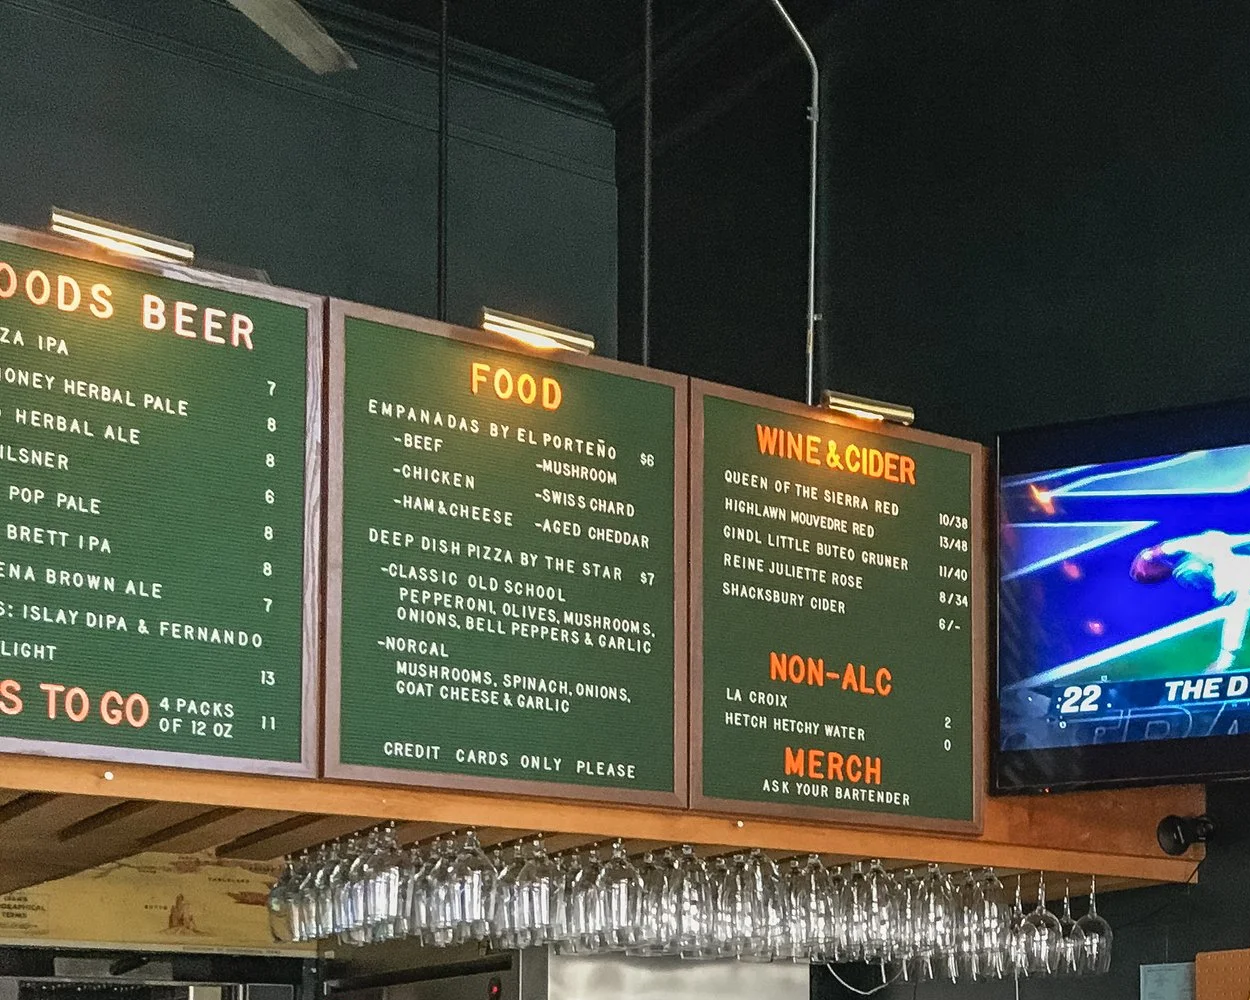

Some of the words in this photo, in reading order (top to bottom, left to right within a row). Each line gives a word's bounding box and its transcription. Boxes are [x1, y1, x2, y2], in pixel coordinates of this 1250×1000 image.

[143, 294, 253, 349] BEER
[39, 336, 68, 355] IPA
[267, 381, 276, 396] 7
[471, 362, 563, 410] FOOD
[0, 368, 55, 390] ONEY
[64, 379, 135, 406] HERBAL
[144, 394, 188, 416] PALE
[268, 417, 276, 432] 8
[16, 409, 93, 436] HERBAL
[105, 425, 140, 444] ALE
[266, 454, 275, 467] 8
[369, 399, 479, 433] EMPANADAS
[490, 423, 509, 438] BY
[518, 428, 537, 444] EL
[641, 453, 654, 466] $6
[394, 433, 443, 452] -BEEF
[536, 459, 616, 485] -MUSHROOM
[9, 486, 44, 504] POP
[57, 493, 101, 514] PALE
[264, 526, 273, 540] 8
[265, 489, 274, 503] 6
[393, 465, 474, 489] -CHICKEN
[535, 489, 585, 508] -SWISS
[590, 498, 634, 517] CHARD
[725, 470, 767, 490] QUEEN
[775, 480, 790, 493] OF
[795, 484, 817, 500] THE
[824, 490, 868, 510] SIERRA
[875, 500, 898, 515] RED
[940, 513, 967, 529] 10/38
[535, 519, 580, 536] -AGED
[588, 527, 648, 548] CHEDDAR
[725, 498, 785, 521] HIGHLAWN
[791, 511, 847, 532] MOUVEDRE
[853, 523, 874, 537] RED
[940, 536, 967, 551] 13/48
[7, 524, 69, 546] BRETT
[79, 535, 110, 553] IPA
[263, 562, 272, 576] 8
[369, 528, 414, 547] DEEP
[422, 536, 460, 555] DISH
[468, 544, 512, 563] PIZZA
[521, 552, 538, 567] BY
[545, 556, 574, 573] THE
[583, 563, 621, 580] STAR
[641, 572, 654, 585] $7
[724, 526, 761, 543] GINDL
[768, 534, 809, 552] LITTLE
[817, 543, 854, 560] BUTEO
[862, 551, 908, 570] GRUNER
[940, 566, 967, 581] 11/40
[46, 569, 114, 591] BROWN
[125, 580, 162, 598] ALE
[263, 598, 272, 612] 7
[381, 563, 457, 585] -CLASSIC
[468, 575, 498, 591] OLD
[505, 580, 565, 602] SCHOOL
[724, 553, 764, 572] REINE
[769, 562, 826, 583] JULIETTE
[832, 573, 862, 589] ROSE
[940, 592, 968, 607] 8/34
[24, 605, 78, 624] ISLAY
[87, 612, 127, 631] DIPA
[138, 619, 149, 634] &
[160, 622, 262, 647] FERNANDO
[723, 582, 804, 606] SHACKSBURY
[811, 597, 845, 613] CIDER
[939, 618, 960, 631] 6/-
[378, 636, 448, 657] -NORCAL
[466, 616, 505, 634] BELL
[512, 622, 579, 644] PEPPERS
[585, 633, 593, 646] &
[599, 635, 651, 653] GARLIC
[1, 641, 56, 660] LIGHT
[261, 671, 275, 685] 13
[769, 651, 892, 697] NON-ALC
[0, 680, 22, 714] S
[40, 684, 89, 721] TO
[101, 691, 148, 727] GO
[160, 697, 169, 711] 4
[177, 699, 234, 717] PACKS
[396, 680, 433, 696] GOAT
[440, 686, 499, 704] CHEESE
[504, 693, 512, 706] &
[517, 695, 569, 713] GARLIC
[727, 688, 741, 701] LA
[750, 691, 787, 708] CROIX
[945, 717, 951, 728] 2
[1165, 677, 1222, 702] THE
[159, 718, 182, 733] OF
[192, 721, 206, 735] 12
[213, 723, 232, 738] OZ
[262, 716, 275, 730] 11
[726, 712, 766, 728] HETCH
[774, 718, 819, 734] HETCHY
[825, 725, 864, 740] WATER
[384, 742, 440, 759] CREDIT
[456, 749, 508, 766] CARDS
[521, 755, 561, 770] ONLY
[577, 761, 635, 778] PLEASE
[784, 746, 882, 785] MERCH
[763, 779, 789, 793] ASK
[796, 783, 828, 797] YOUR
[836, 787, 909, 805] BARTENDER
